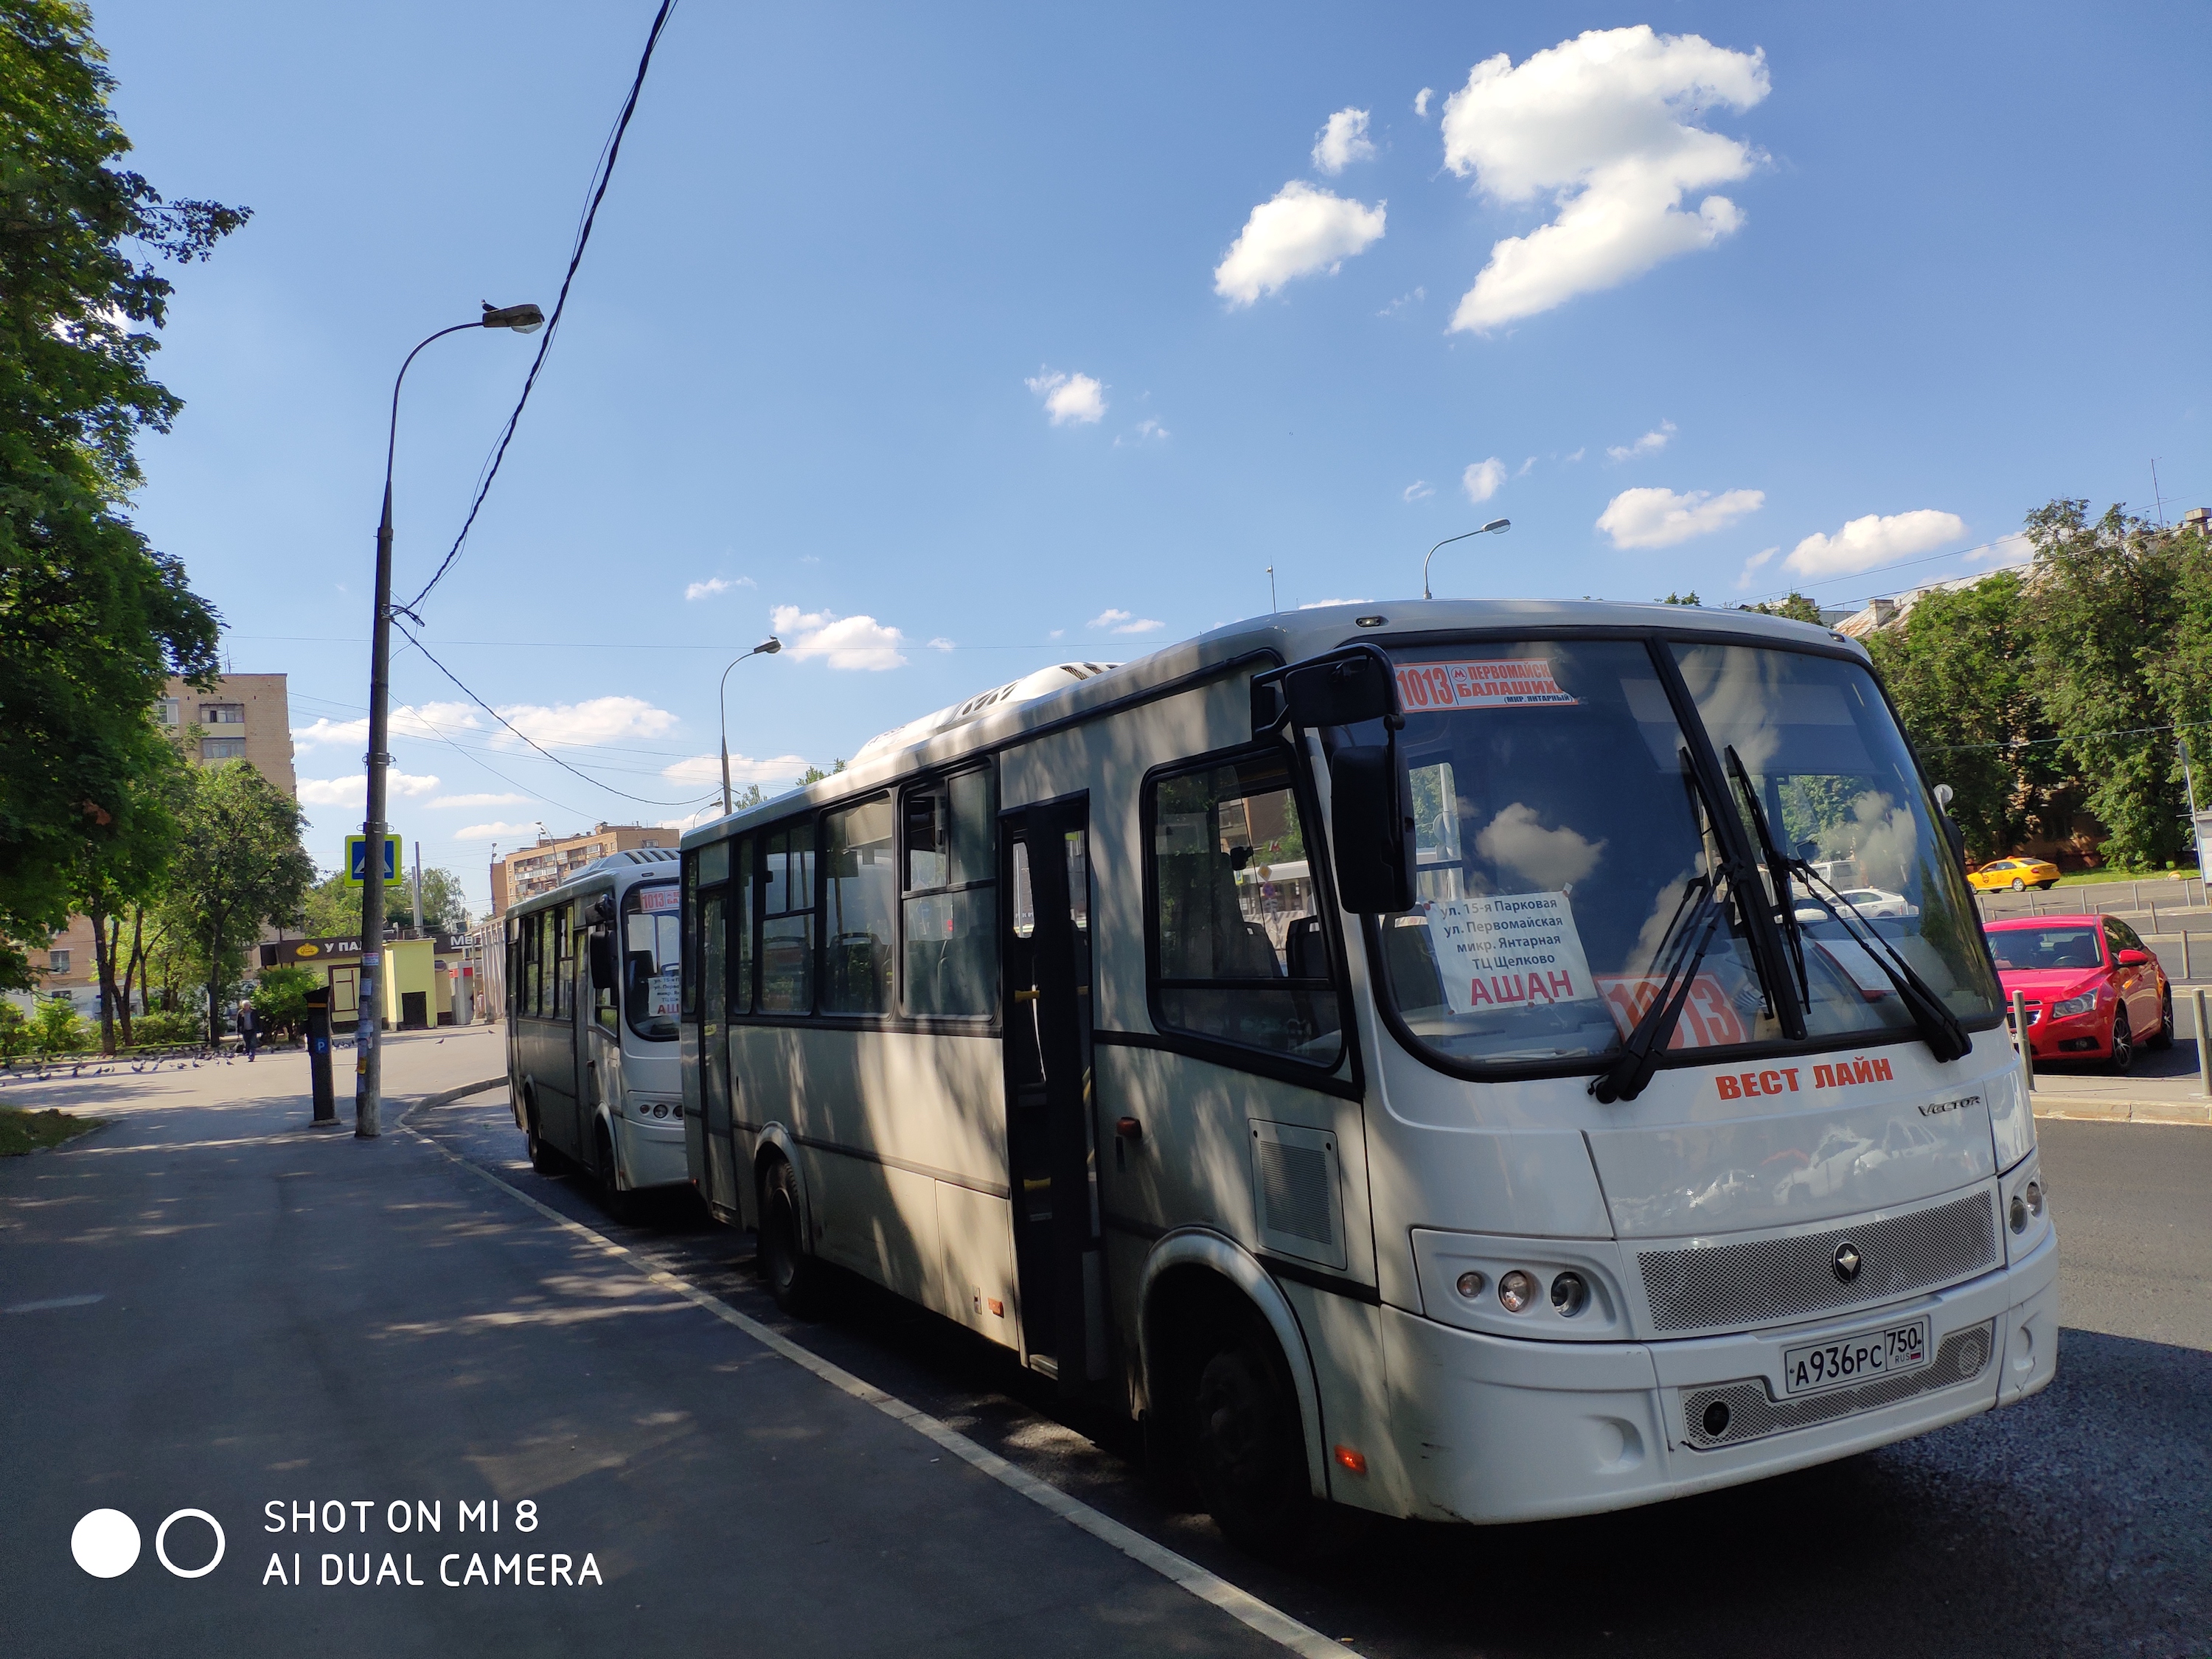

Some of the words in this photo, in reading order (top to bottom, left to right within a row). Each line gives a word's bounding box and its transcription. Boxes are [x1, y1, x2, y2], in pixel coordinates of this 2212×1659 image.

[1397, 667, 1455, 706] 1013
[642, 893, 664, 909] 1013
[1440, 907, 1461, 920] ул.
[1464, 902, 1492, 914] 15-я
[1495, 899, 1557, 914] Парковая
[1444, 926, 1464, 939] ул.
[1467, 917, 1563, 934] Первомайская
[324, 943, 334, 953] У
[1457, 941, 1497, 953] микр.
[1498, 935, 1561, 949] Янтарная
[1472, 958, 1493, 970] ТЦ
[1494, 954, 1555, 970] Щелково
[1471, 970, 1574, 1006] АШАН
[1715, 1068, 1799, 1100] ВЕСТ
[1812, 1056, 1893, 1089] ЛАЙН
[1795, 1344, 1883, 1386] А936РС
[1886, 1327, 1918, 1356] 750
[1894, 1353, 1910, 1364] RUS
